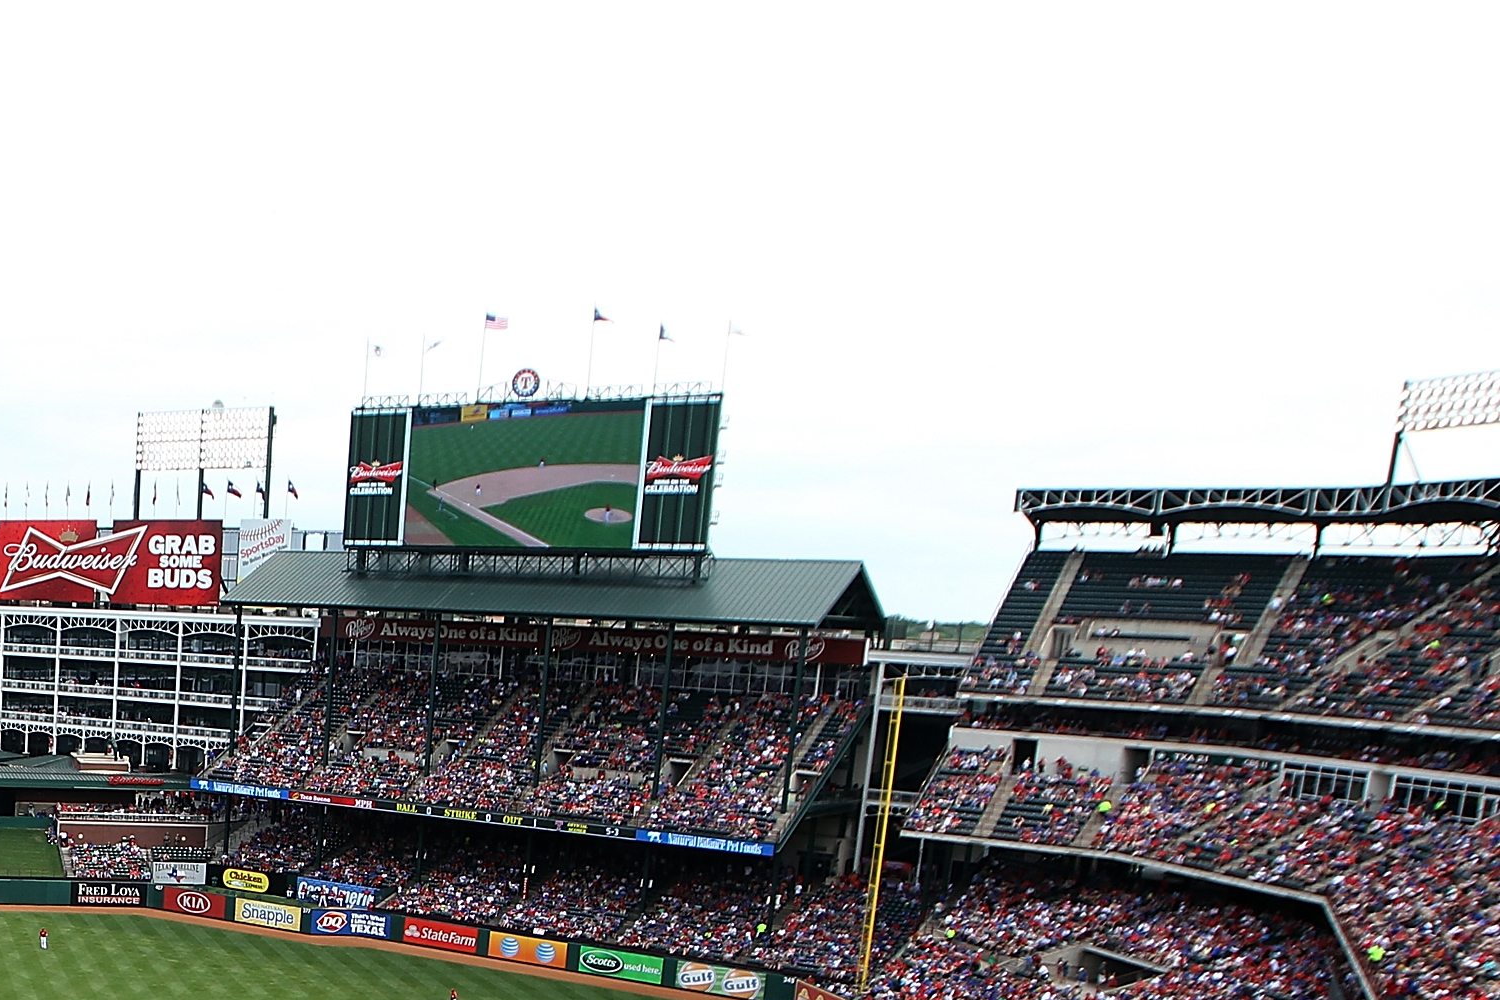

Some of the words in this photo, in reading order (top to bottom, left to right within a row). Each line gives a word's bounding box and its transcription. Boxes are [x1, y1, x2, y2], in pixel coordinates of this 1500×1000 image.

[350, 465, 402, 478] Budweiser
[646, 461, 712, 474] Budweiser
[350, 487, 393, 495] CELEBRATION
[645, 485, 698, 494] CELEBRATION
[148, 535, 216, 555] GRAB
[240, 533, 285, 559] SportsDay
[3, 543, 137, 572] Budweiser
[159, 555, 203, 568] SOME
[147, 568, 213, 589] BUDS
[347, 623, 374, 638] Pepper
[380, 622, 435, 640] Always
[438, 627, 466, 639] One
[469, 626, 485, 640] of
[487, 631, 496, 641] a
[499, 628, 538, 643] Kind
[589, 631, 652, 650] Always
[692, 635, 712, 651] of
[714, 642, 724, 652] a
[728, 638, 774, 655] Kind
[213, 781, 234, 793] Natural
[354, 799, 373, 808] MPH
[397, 803, 418, 813] BALL
[444, 808, 477, 820] STRIKE
[502, 815, 524, 825] OUT
[606, 827, 620, 836] 5-3
[668, 833, 696, 847] Natural
[697, 836, 726, 850] Balance
[739, 842, 763, 854] Foods
[155, 863, 171, 873] TEXAS
[173, 864, 200, 873] WIRELINE
[229, 871, 263, 883] Chicken
[78, 883, 108, 896] FRED
[111, 883, 140, 897] LOYA
[78, 896, 140, 905] INSURANCE
[182, 895, 205, 910] KIA
[242, 902, 294, 926] Snapple
[351, 913, 369, 921] That's
[322, 915, 343, 927] DQ
[367, 920, 385, 928] About
[350, 924, 387, 937] TEXAS.
[586, 954, 617, 968] Scotts
[624, 963, 641, 972] used
[642, 964, 661, 975] here.
[680, 971, 713, 985] Gulf
[723, 978, 758, 992] Gulf
